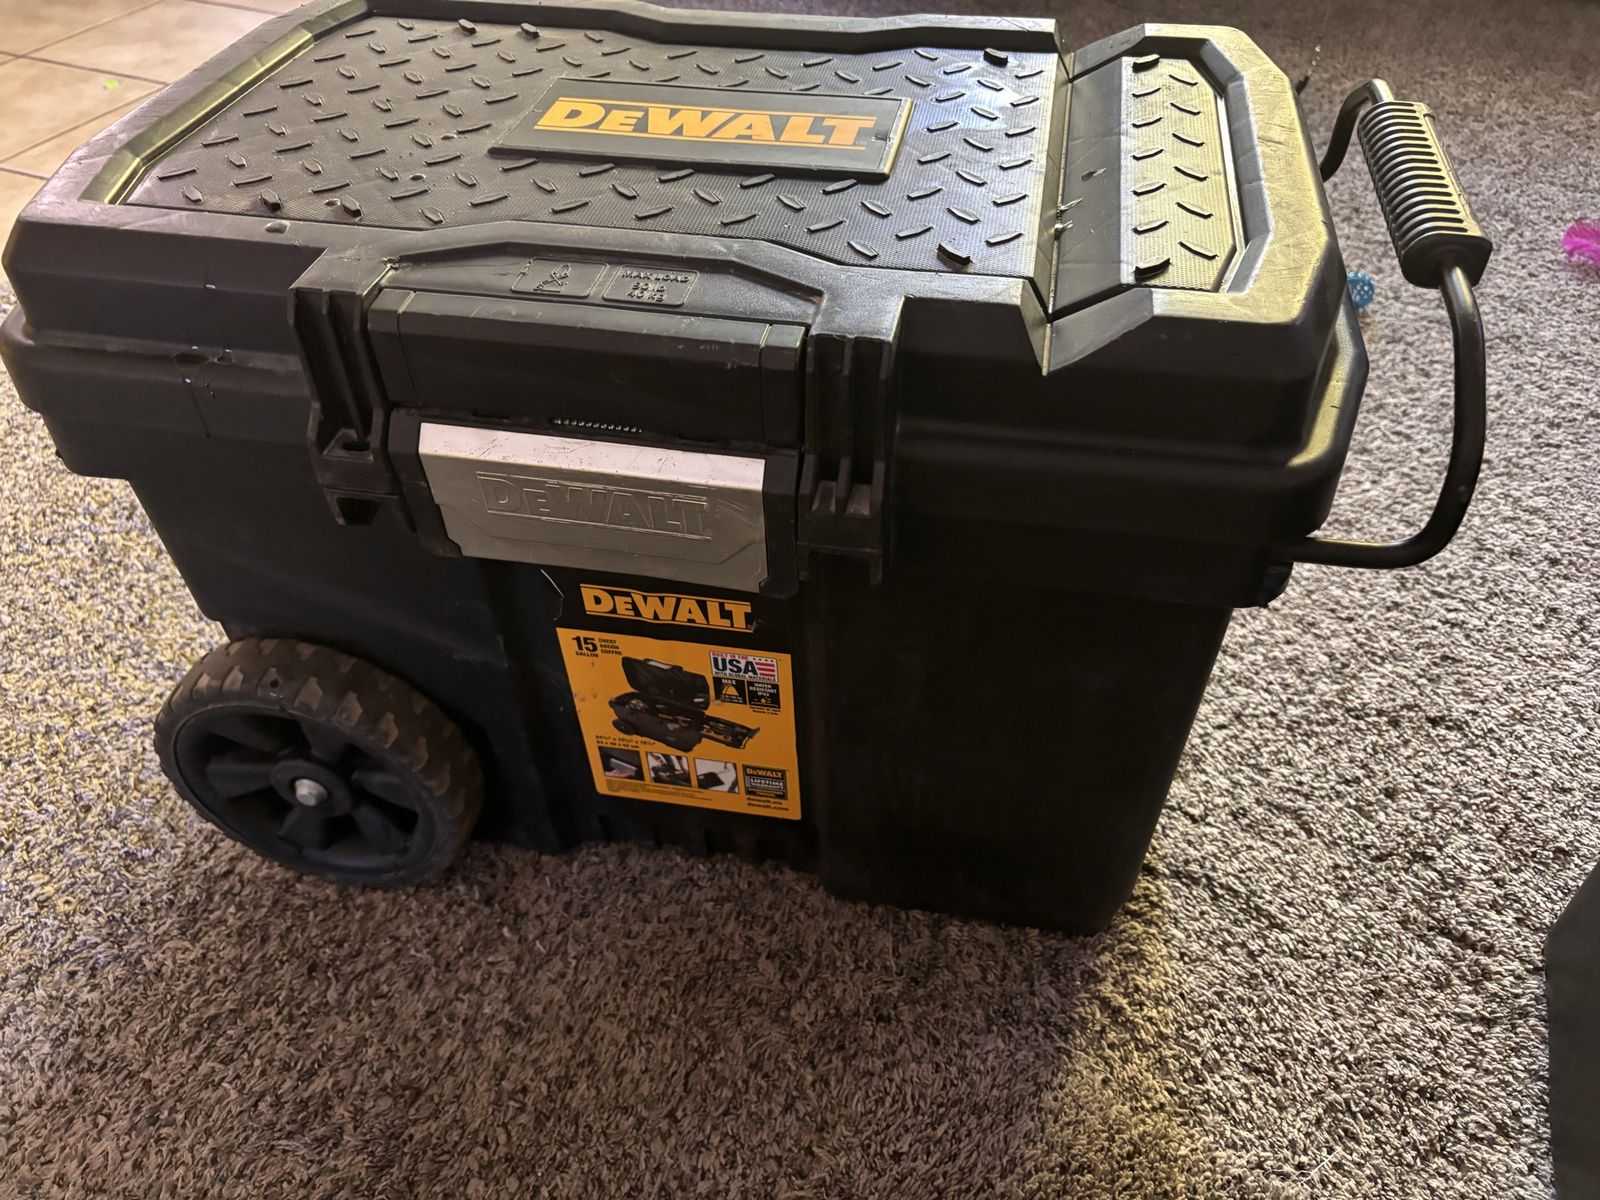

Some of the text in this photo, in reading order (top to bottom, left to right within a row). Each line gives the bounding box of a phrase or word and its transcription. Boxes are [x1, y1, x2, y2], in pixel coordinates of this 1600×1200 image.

[535, 98, 876, 150] DEWALT
[621, 269, 690, 284] MAX LOAD
[580, 584, 754, 633] DEWALT
[571, 636, 598, 652] 15
[712, 657, 759, 676] USA
